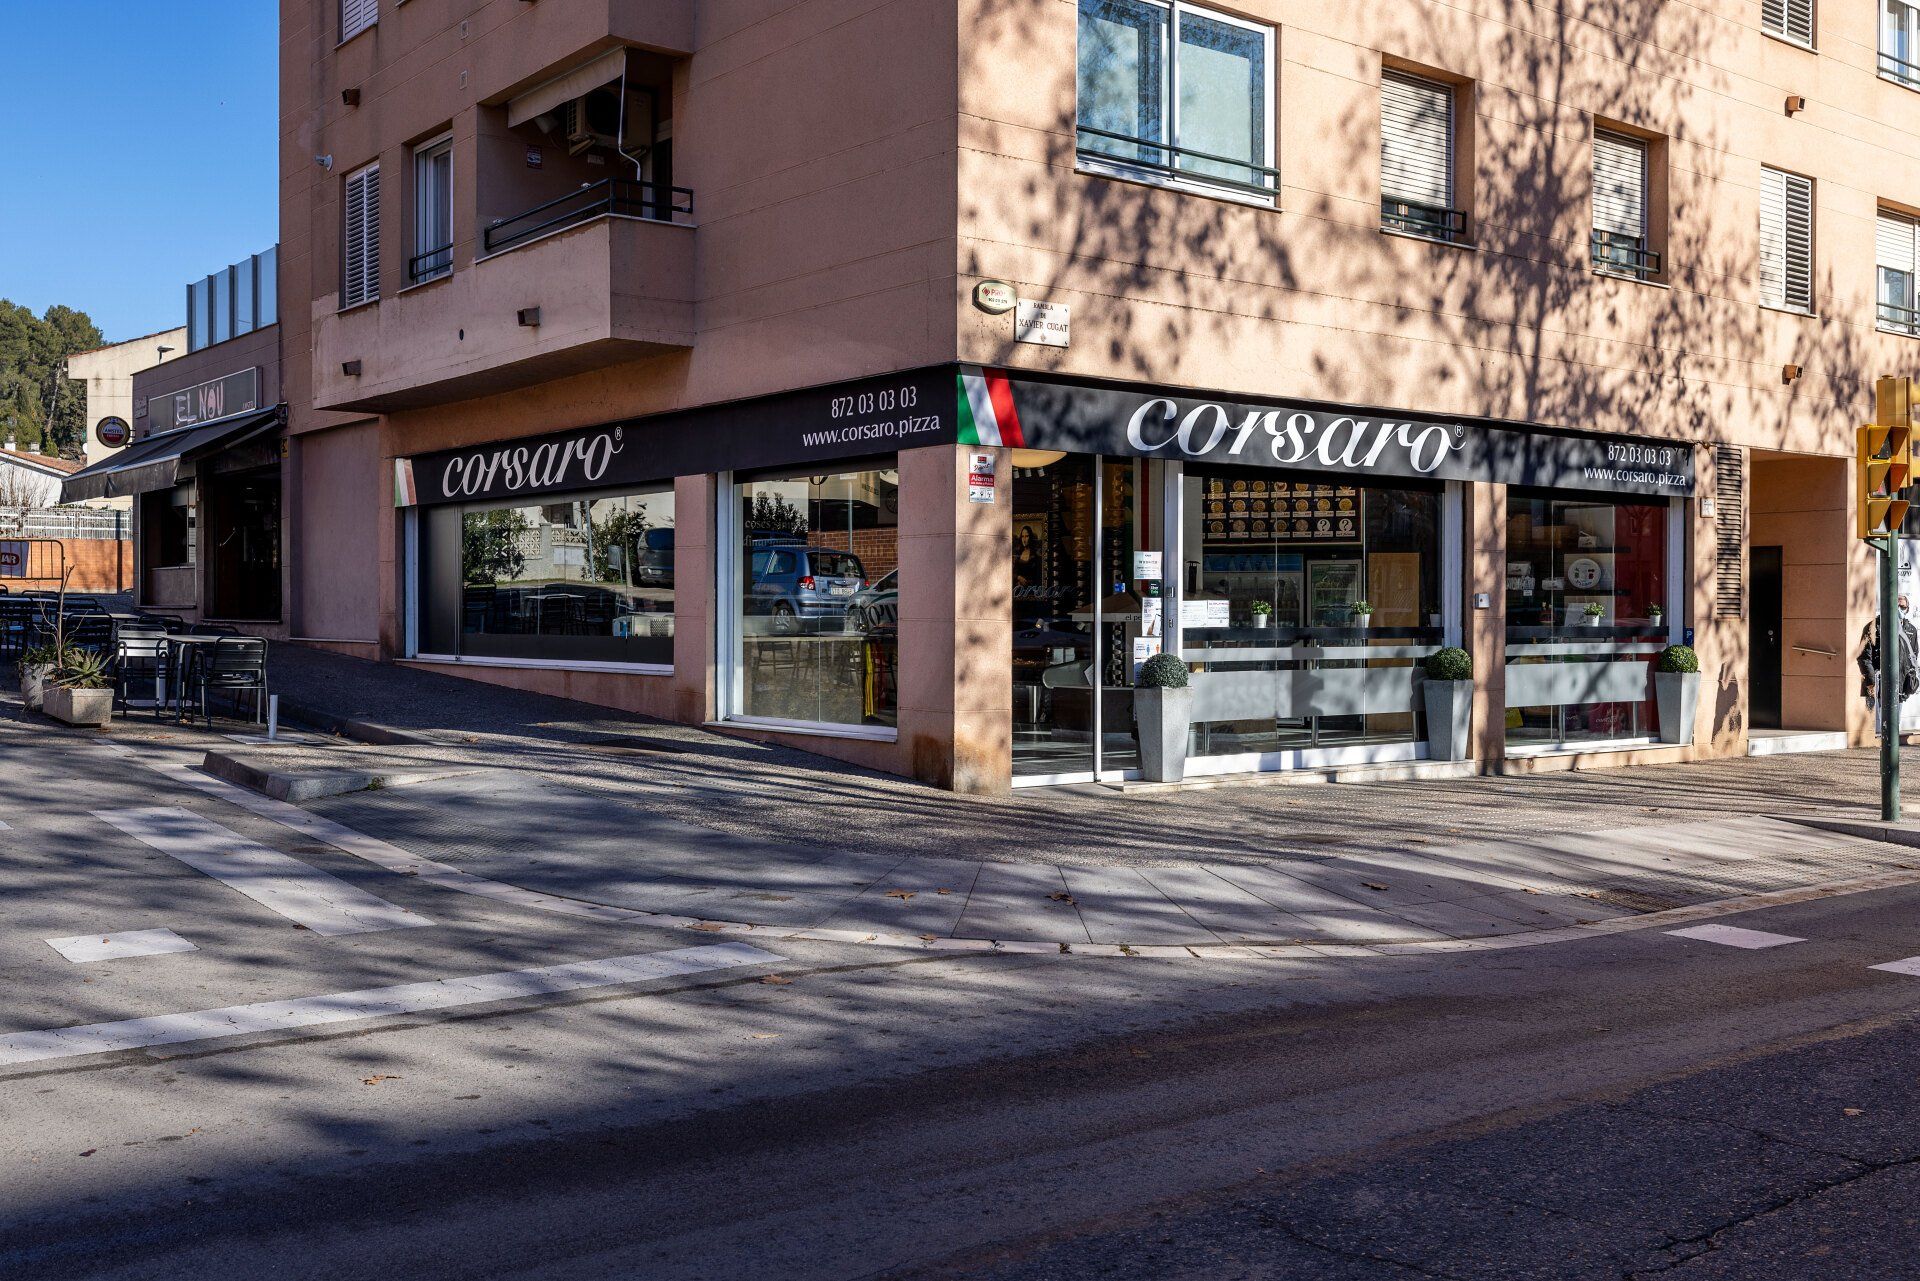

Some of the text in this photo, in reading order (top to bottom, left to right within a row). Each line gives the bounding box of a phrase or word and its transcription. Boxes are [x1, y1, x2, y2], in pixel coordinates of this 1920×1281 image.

[1033, 302, 1054, 311] RAMBLA
[1018, 318, 1069, 333] XAVIER CUGAT
[175, 391, 198, 426] EL
[199, 380, 224, 421] NOU
[831, 385, 917, 418] 872 03 03 03
[802, 415, 941, 447] www.corsaro.pizza
[1608, 444, 1671, 466] 872 03 03 03
[970, 474, 994, 483] Alarma
[1583, 467, 1686, 487] www.corsaro.pizza
